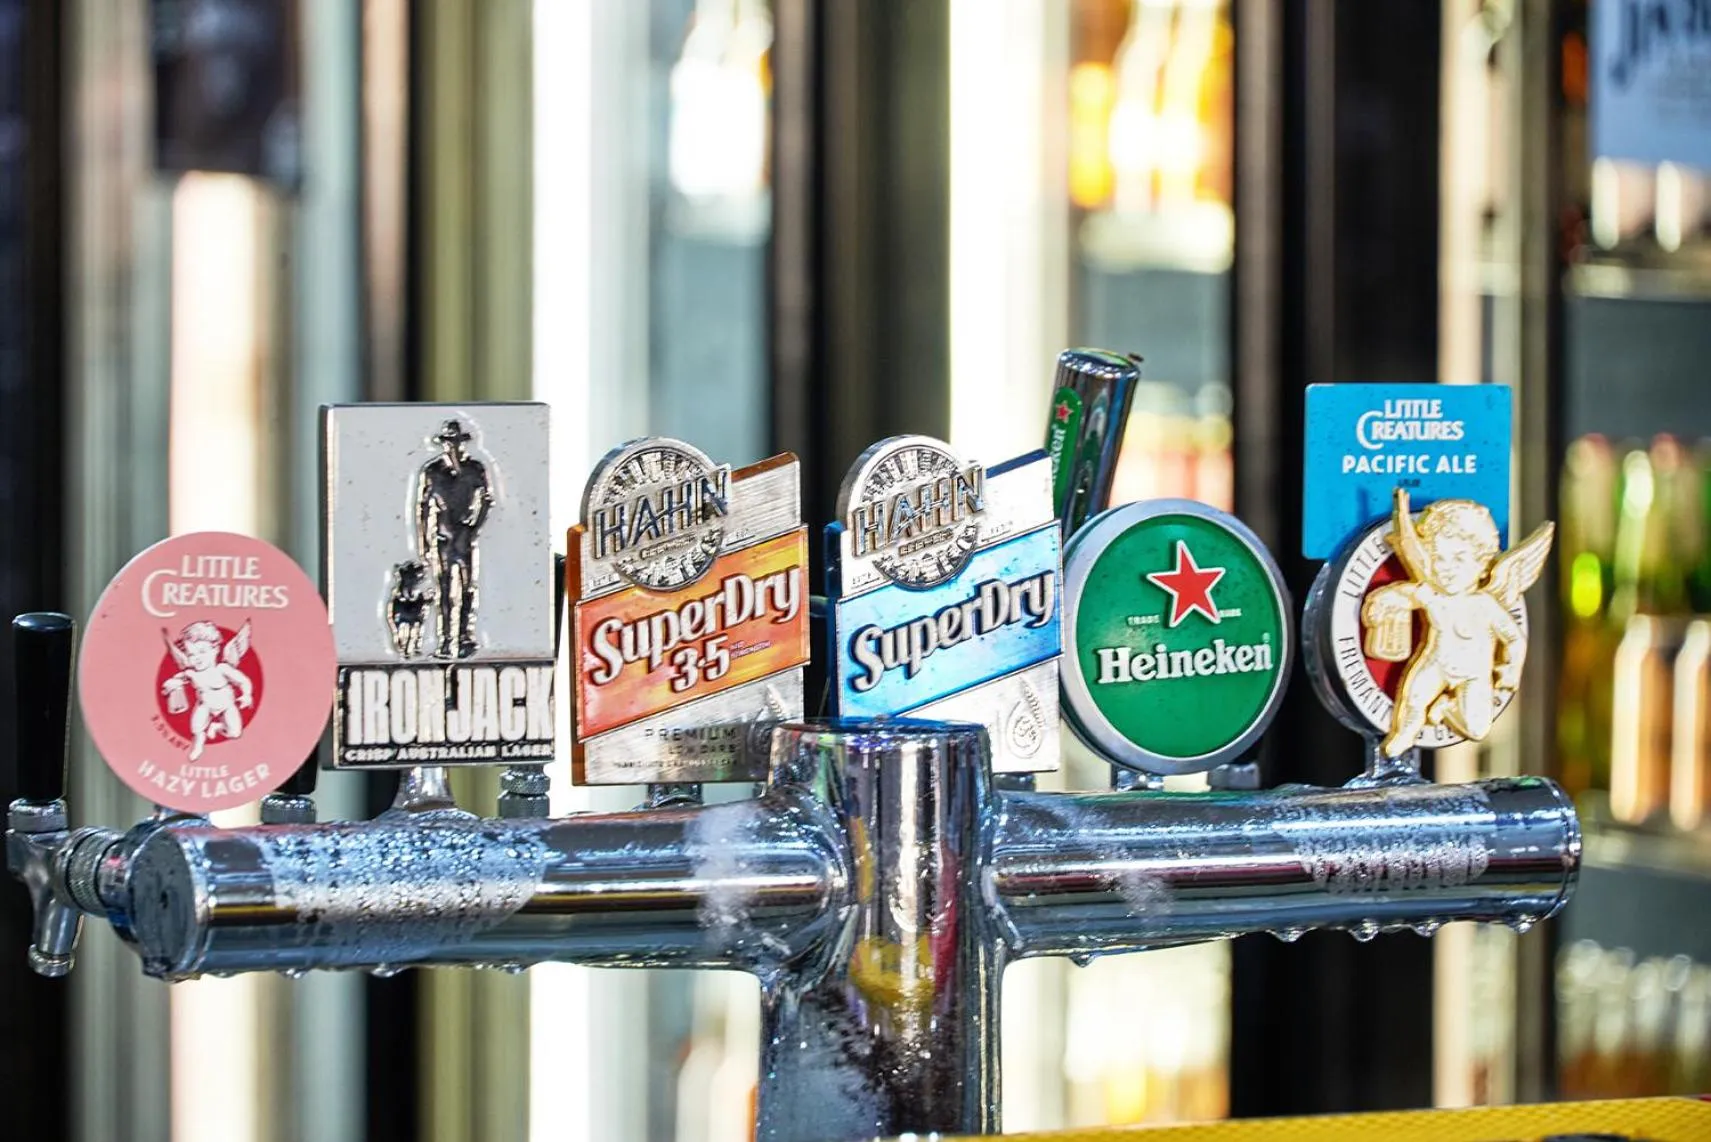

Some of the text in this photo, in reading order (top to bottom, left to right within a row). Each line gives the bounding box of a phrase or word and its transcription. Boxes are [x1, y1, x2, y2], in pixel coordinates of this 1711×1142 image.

[1384, 399, 1443, 419] LITTLE
[1356, 411, 1465, 449] CREATURES
[1342, 454, 1478, 473] PACIFIC ALE
[594, 468, 730, 559] HAHN
[853, 465, 985, 558] HAHN
[180, 555, 262, 579] LITTLE
[141, 569, 289, 617] CREATURES
[1097, 632, 1274, 684] Heineken
[1338, 635, 1394, 722] FREMANT
[180, 764, 229, 778] LITTLE
[345, 747, 395, 762] CRISP
[396, 745, 496, 760] AUSTRALIAN
[137, 760, 272, 798] HAZY LAGER
